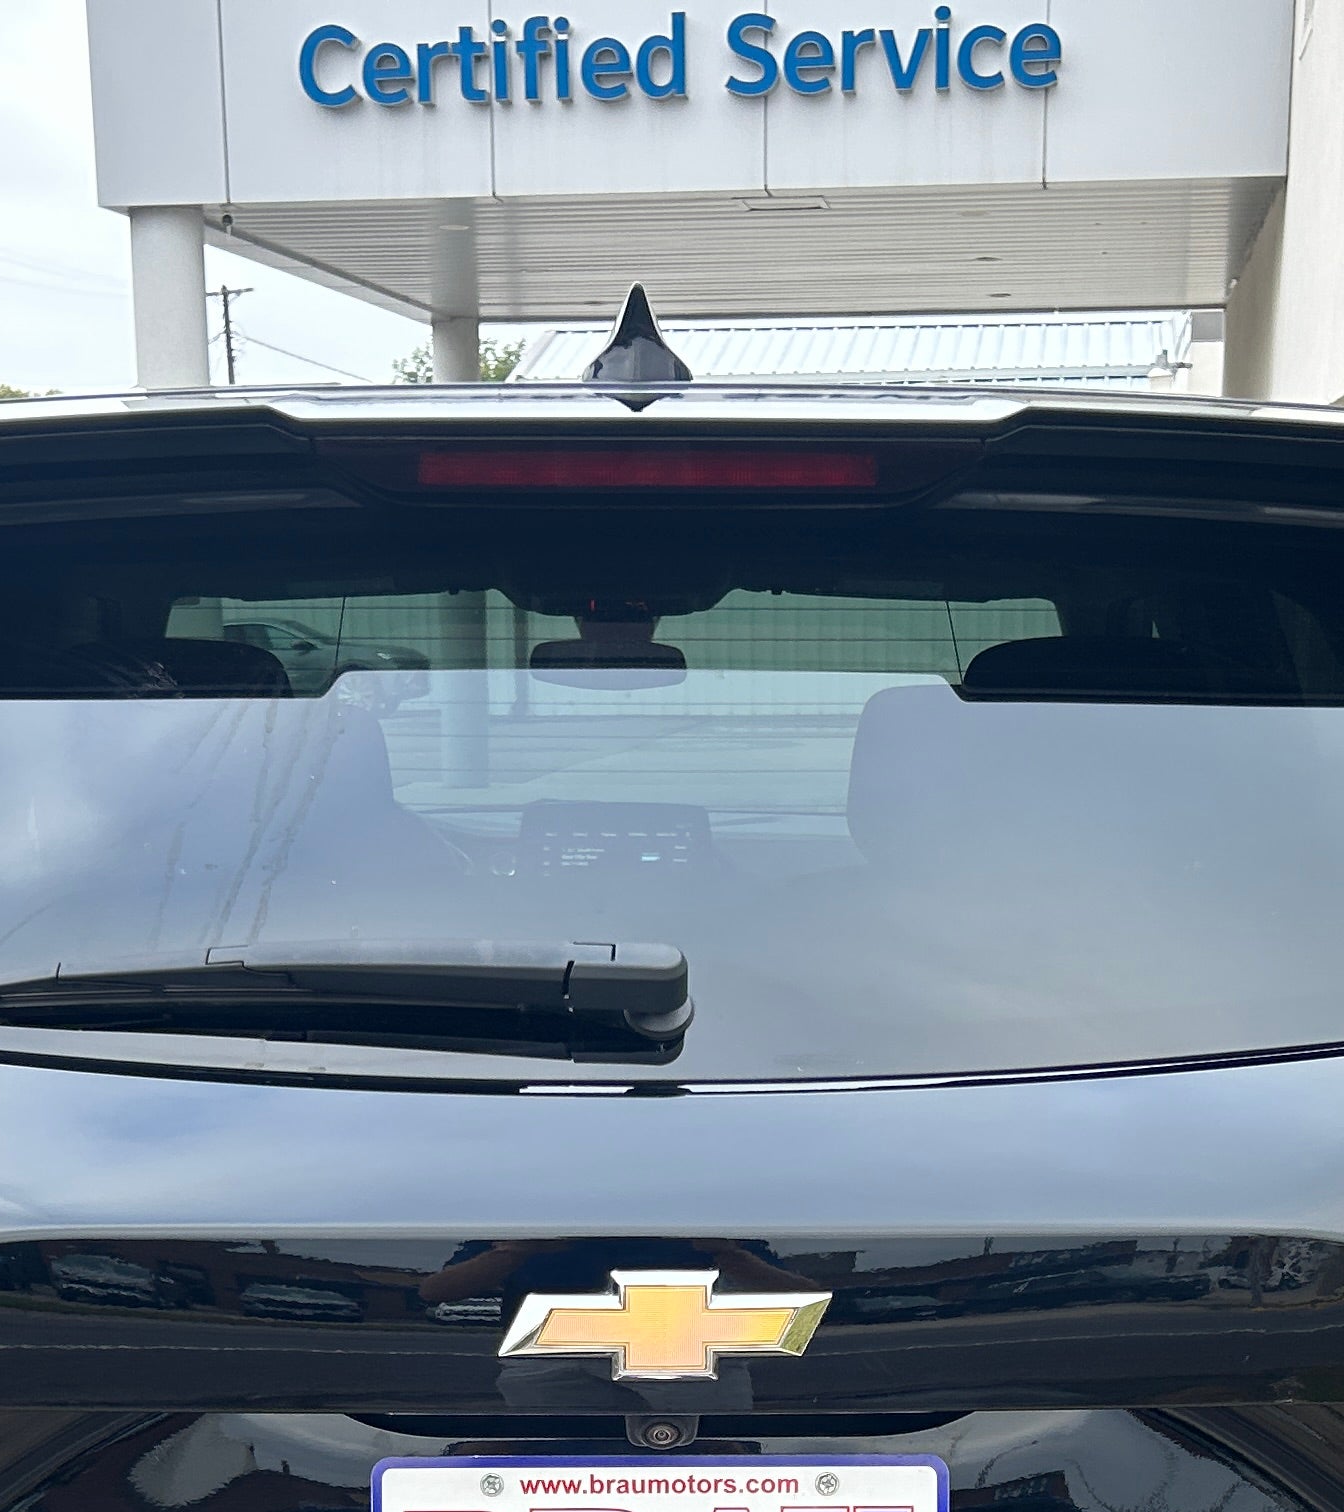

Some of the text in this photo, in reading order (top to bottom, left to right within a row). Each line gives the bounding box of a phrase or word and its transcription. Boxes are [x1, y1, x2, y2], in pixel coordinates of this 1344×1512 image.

[299, 6, 1062, 109] Certified Service
[520, 1475, 800, 1496] www.braumotors.com
